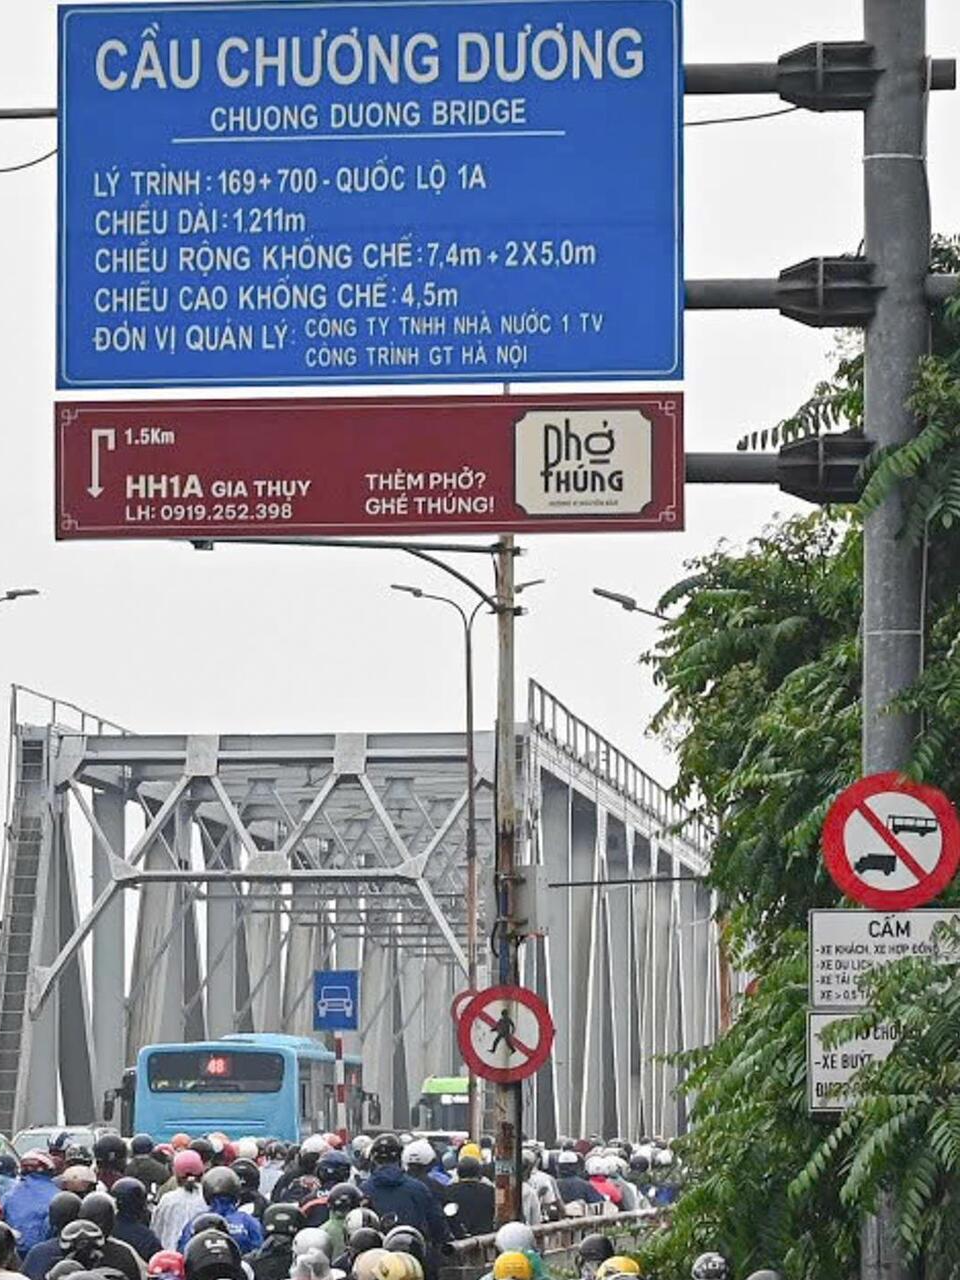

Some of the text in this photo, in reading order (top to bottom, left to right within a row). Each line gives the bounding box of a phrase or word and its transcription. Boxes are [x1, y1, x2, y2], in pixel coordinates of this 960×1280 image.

[95, 22, 645, 91] CẦU CHƯƠNG DƯƠNG
[210, 98, 527, 132] CHUONG DUONG BRIDGE
[93, 165, 120, 198] LÝ
[336, 155, 406, 194] QUỐC
[416, 159, 446, 196] LỘ
[457, 164, 487, 190] 1A
[178, 240, 251, 277] RỘNG
[262, 234, 353, 271] KHỐNG
[178, 285, 229, 312] CAO
[238, 274, 328, 310] KHỐNG
[92, 320, 147, 353] ĐƠN
[154, 325, 176, 354] VỊ
[185, 316, 254, 352] QUẢN
[304, 314, 358, 339] CÔNG
[366, 315, 390, 337] TY
[399, 315, 446, 336] TNHH
[452, 309, 492, 336] NHÀ
[500, 308, 552, 335] NƯỚC
[561, 314, 570, 334] 1
[579, 313, 605, 334] TV
[304, 340, 528, 369] CÔNG TRÌNH GT HÀ NỘI
[124, 427, 176, 446] 1.5Km
[125, 474, 312, 502] HH1A GIA THỤY
[364, 465, 487, 491] THÈM PHỞ?
[125, 502, 293, 522] LH: 0919.252.398
[364, 490, 496, 515] GHÉ THÚNG!
[868, 914, 911, 939] CẤM
[206, 1058, 226, 1075] 48
